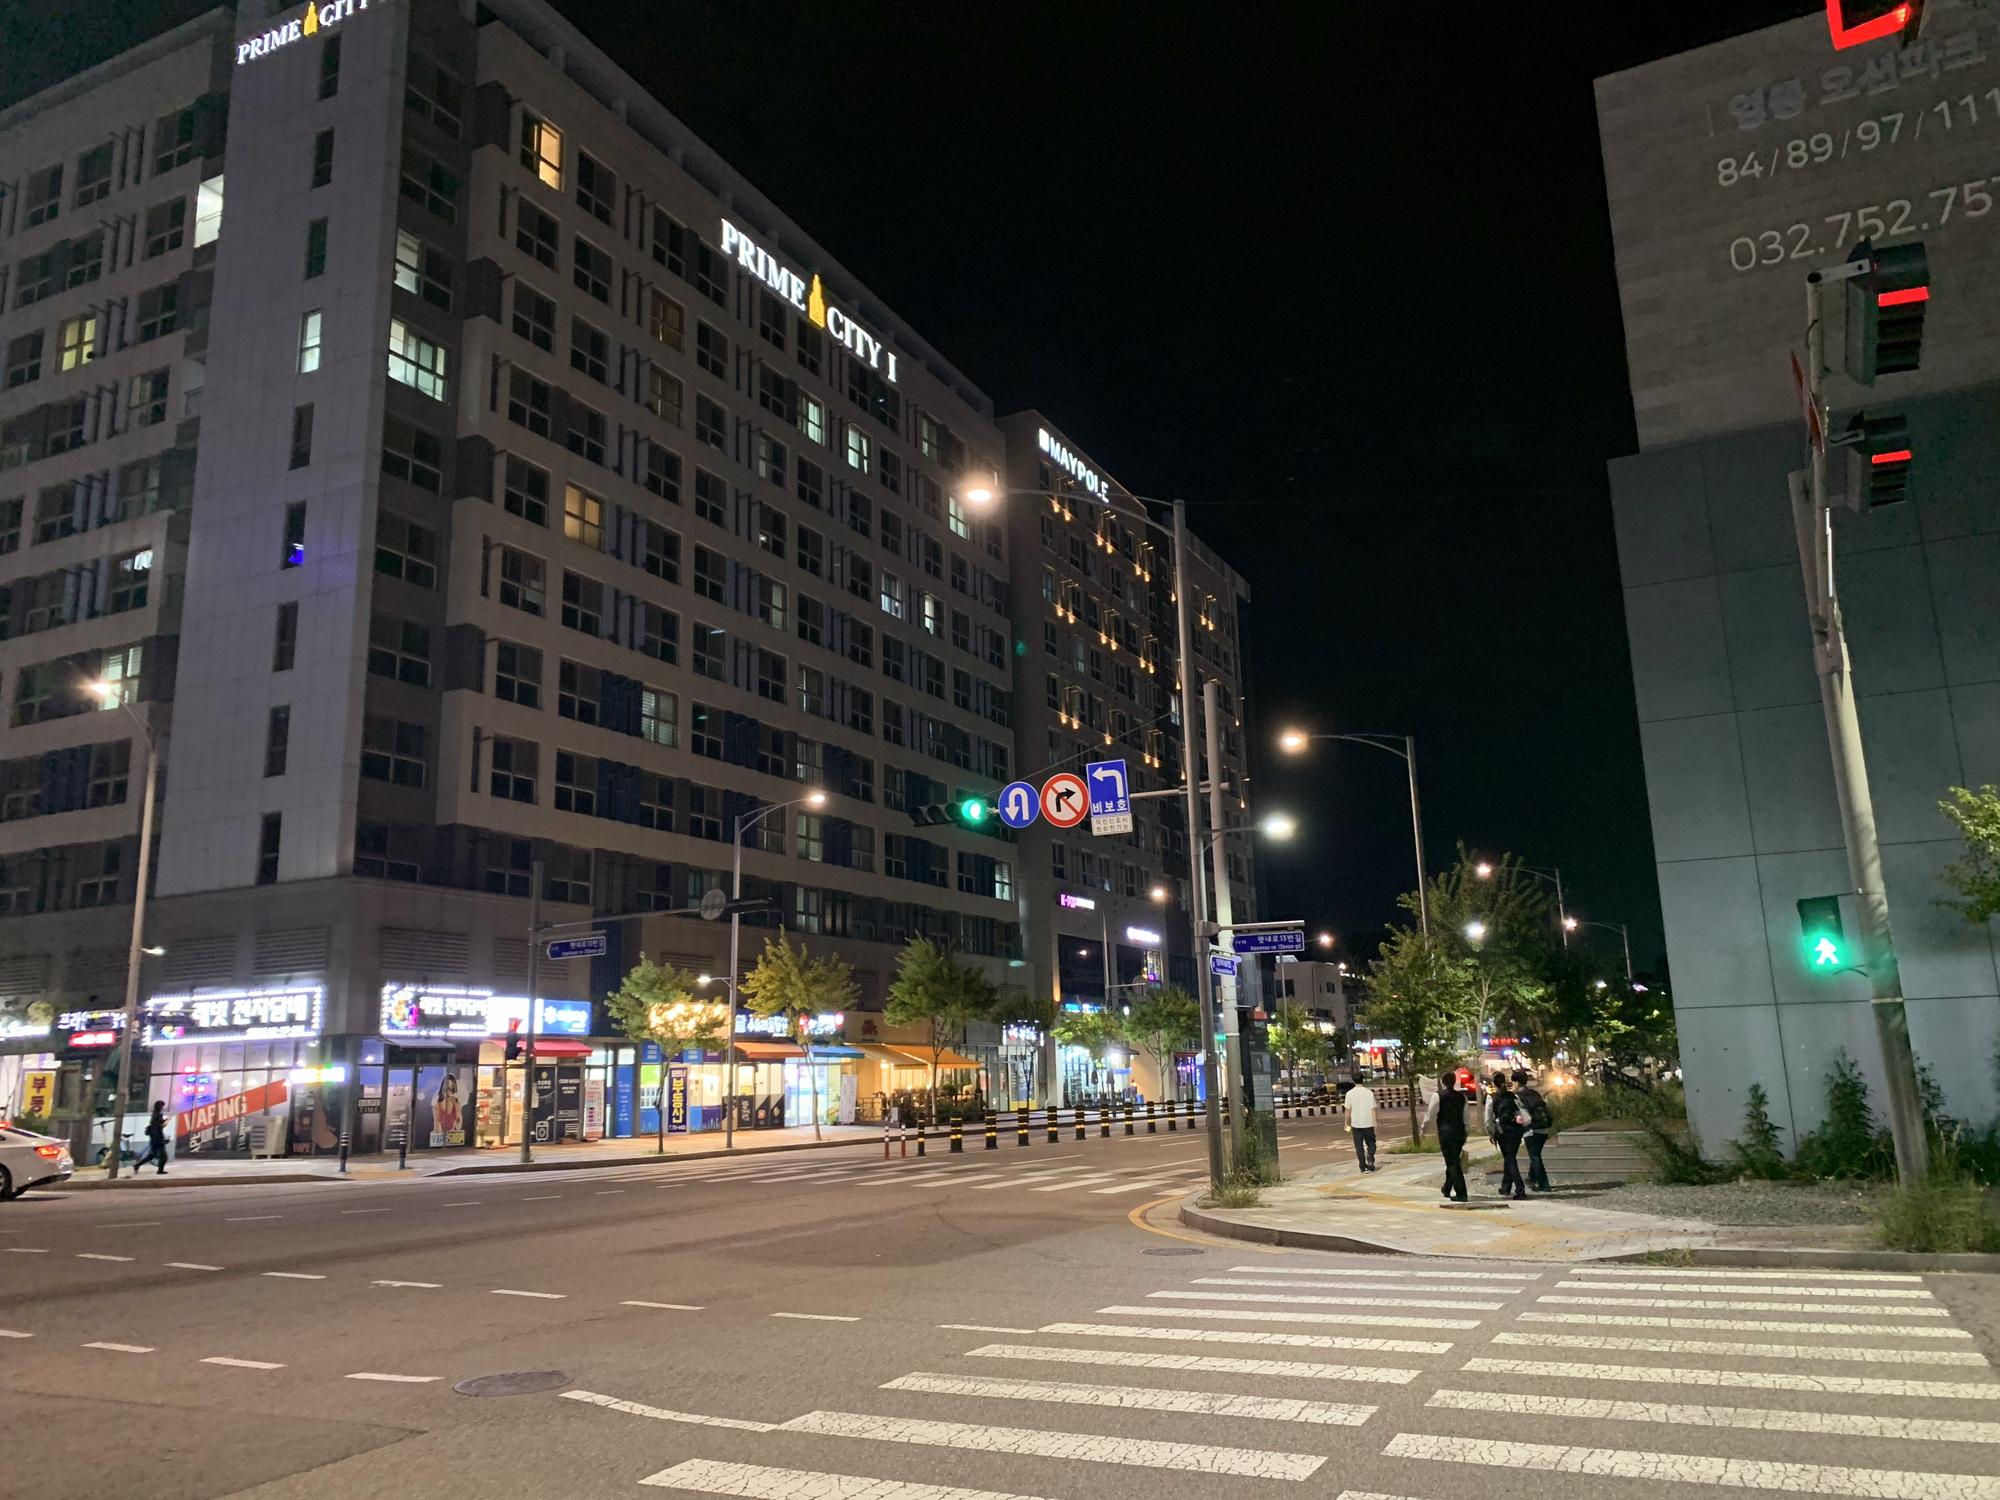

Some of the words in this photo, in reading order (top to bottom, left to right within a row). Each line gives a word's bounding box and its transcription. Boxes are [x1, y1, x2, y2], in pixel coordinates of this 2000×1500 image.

[237, 19, 302, 65] PRIME
[1730, 176, 2000, 271] 032.752.75
[721, 218, 806, 311] PRIME
[827, 307, 882, 368] CITY
[1050, 436, 1109, 503] MAYPOLE
[1092, 798, 1128, 815] 비보호
[232, 994, 308, 1025] 전자담배
[31, 1076, 47, 1117] 부동
[183, 1095, 248, 1132] VAPING
[672, 1077, 685, 1124] 부동산
